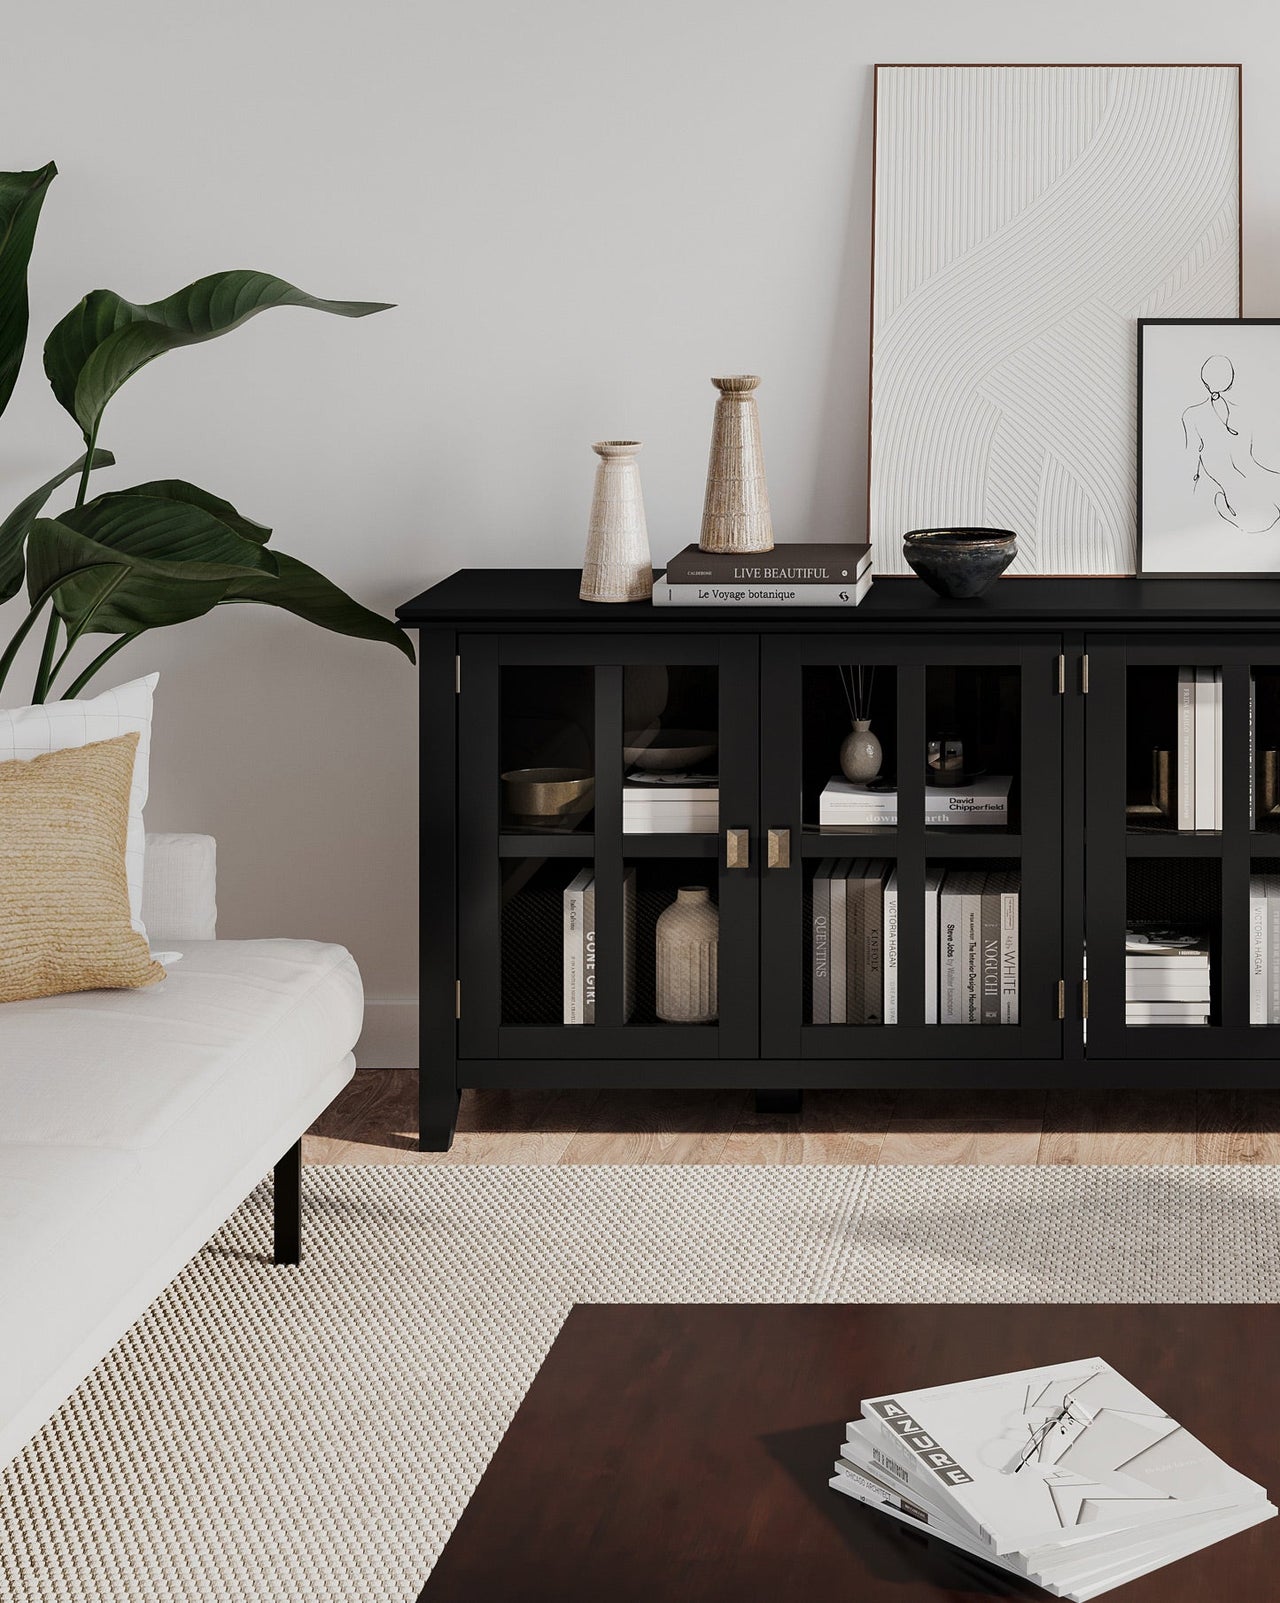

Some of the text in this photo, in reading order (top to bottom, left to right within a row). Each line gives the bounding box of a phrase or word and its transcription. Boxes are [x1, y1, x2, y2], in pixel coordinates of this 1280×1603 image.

[734, 567, 830, 579] LIVE BEAUTIFUL
[698, 589, 796, 602] Le Voyage botanique
[866, 814, 897, 822] down
[949, 804, 1004, 812] Chipperfield
[888, 900, 897, 938] VICTORIA
[1254, 907, 1262, 945] VICTORIA
[815, 916, 826, 978] QUENTINS
[871, 928, 879, 973] KINFOLK
[888, 940, 897, 968] HAGAN
[1254, 947, 1262, 975] HAGAN
[586, 931, 596, 1005] GONE GIRL
[946, 924, 954, 1016] Steve Jobs by Walter Isaacson
[968, 942, 976, 1023] The Interior Design Handbook
[984, 940, 998, 996] NOGUCHI
[1003, 950, 1016, 995] WHITE
[883, 1401, 972, 1485] AZURE
[845, 1470, 866, 1488] CHICAGO
[866, 1479, 892, 1501] ARCHITECT
